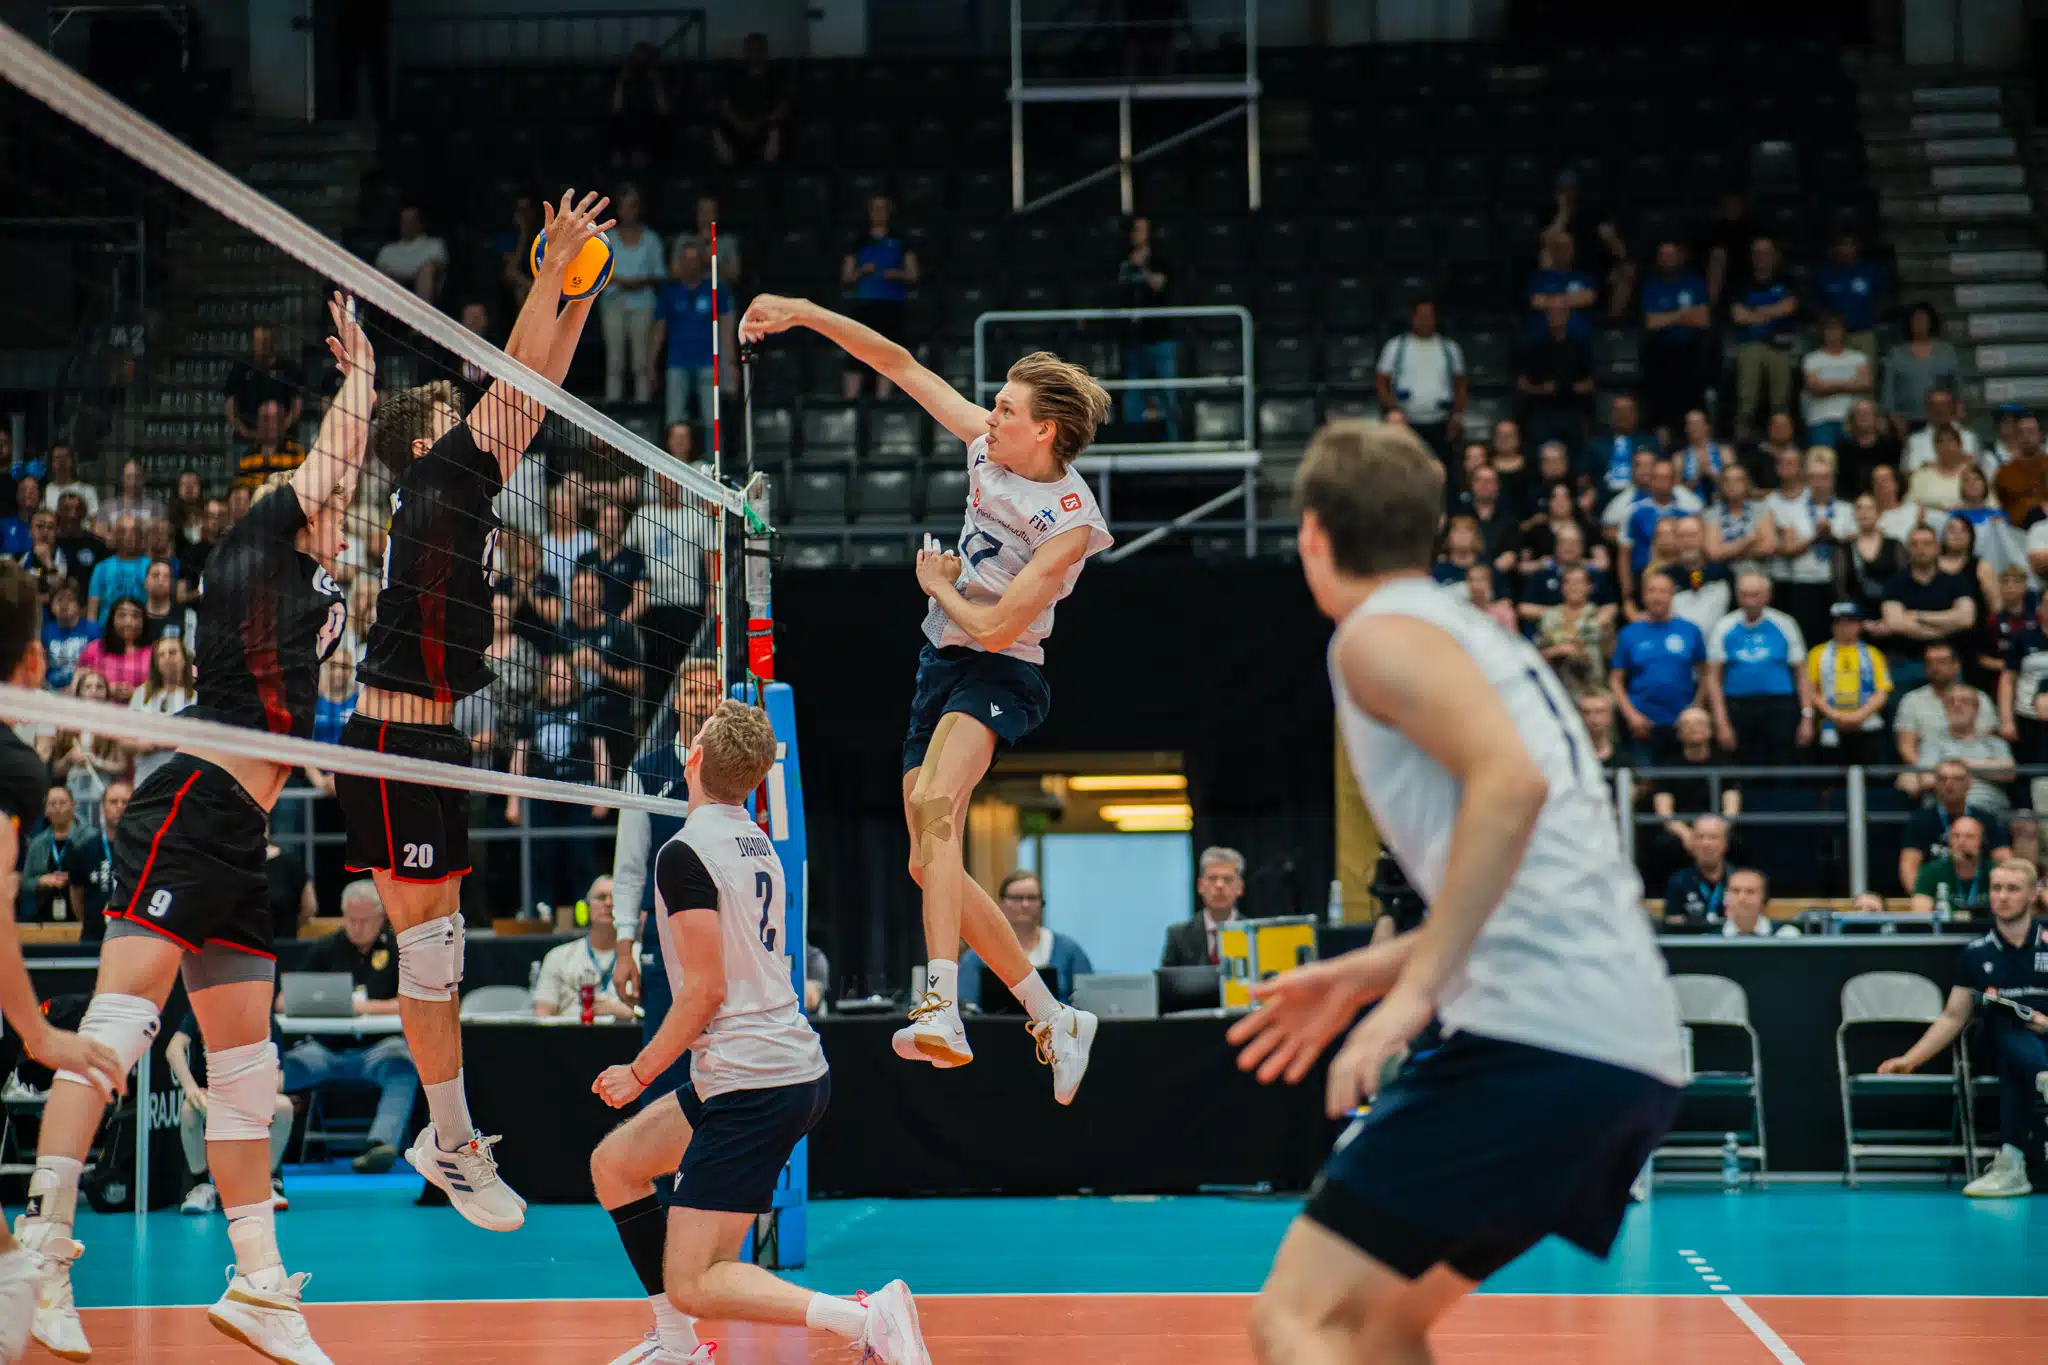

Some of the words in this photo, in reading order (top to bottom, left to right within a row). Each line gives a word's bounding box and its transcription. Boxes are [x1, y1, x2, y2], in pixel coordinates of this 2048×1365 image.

[402, 842, 434, 868] 20
[735, 836, 772, 857] IVANOV
[147, 889, 172, 917] 9
[755, 870, 777, 952] 2
